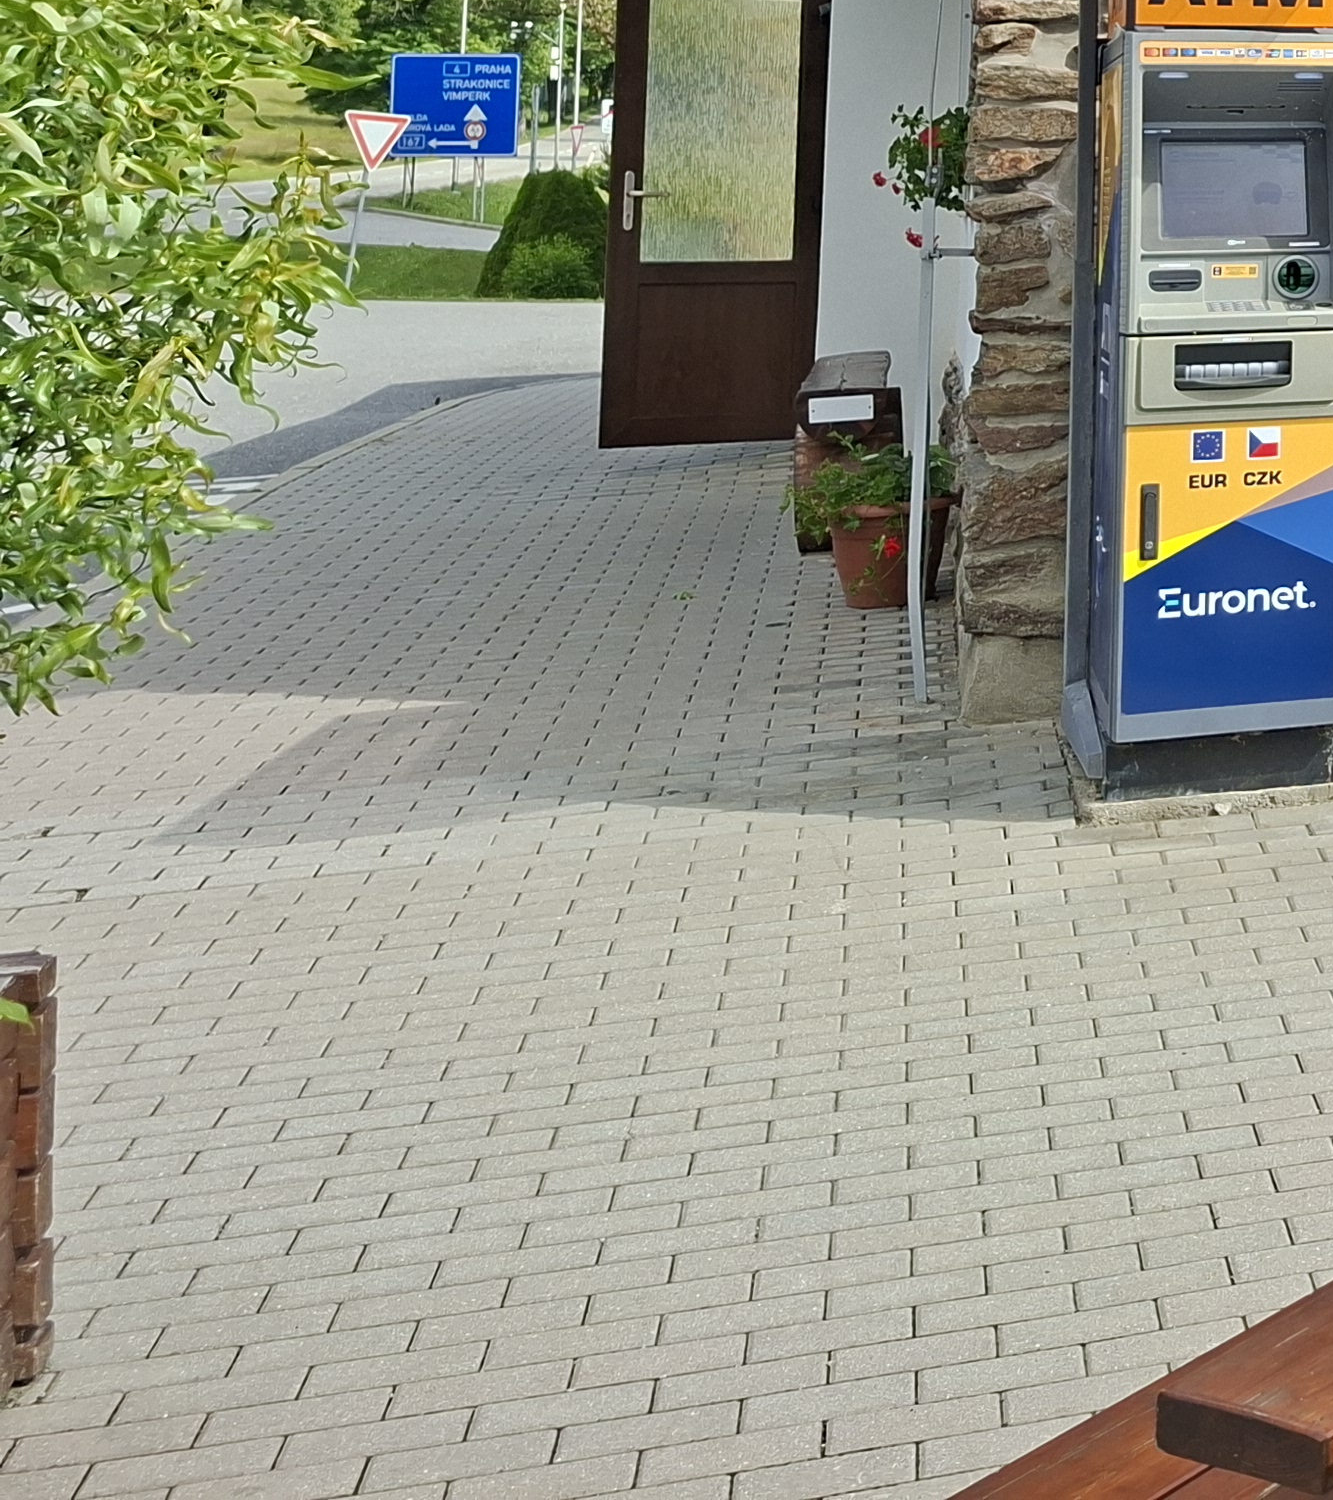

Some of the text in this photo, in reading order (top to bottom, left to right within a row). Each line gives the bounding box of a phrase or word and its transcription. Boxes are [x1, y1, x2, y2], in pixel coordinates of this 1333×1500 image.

[453, 64, 512, 74] 4 PRAHA
[442, 78, 511, 89] STRAKONICE
[442, 90, 491, 101] VIMPERK
[434, 123, 456, 132] LADA
[402, 137, 420, 147] 167
[1188, 470, 1283, 489] EUR CZK
